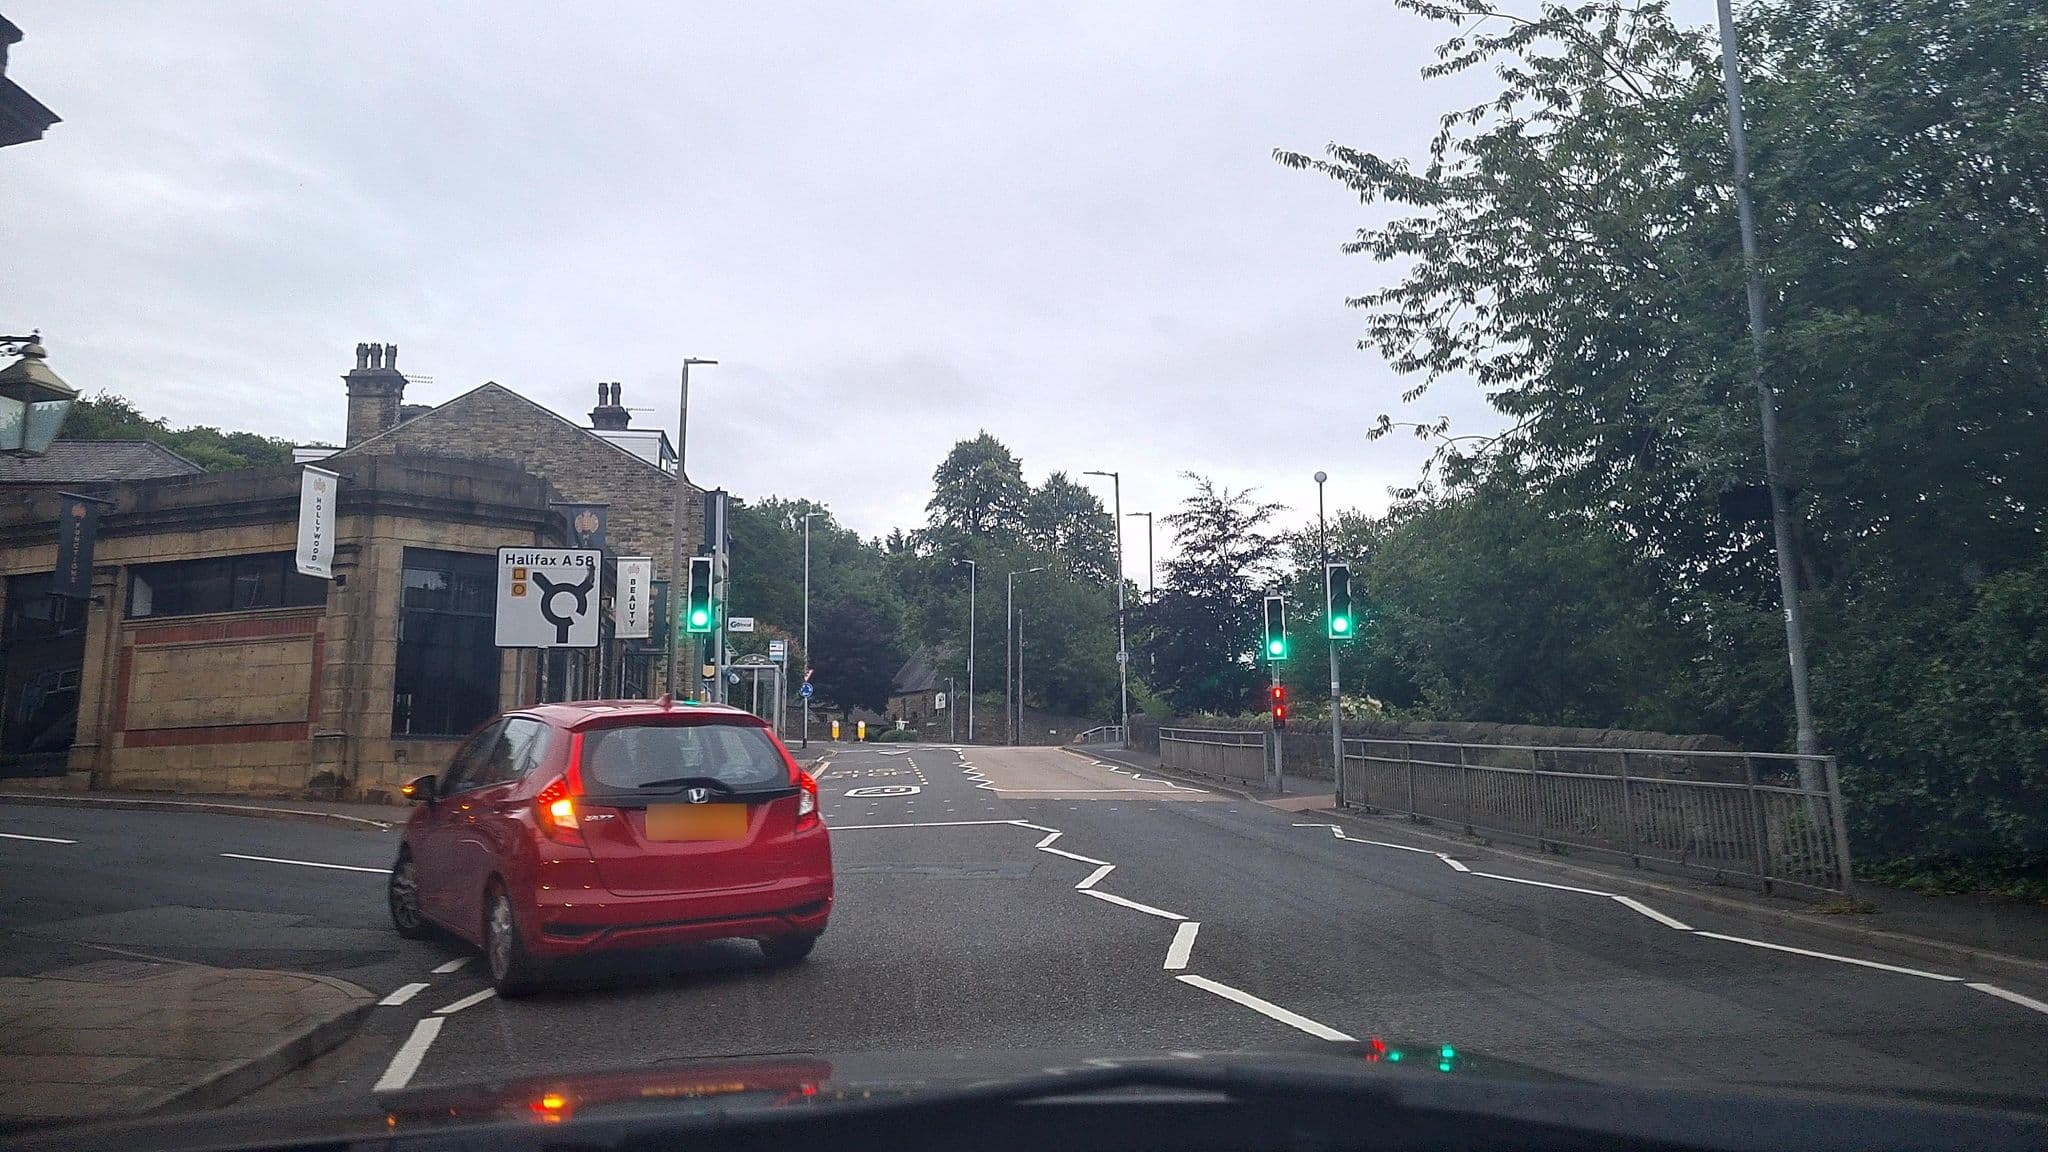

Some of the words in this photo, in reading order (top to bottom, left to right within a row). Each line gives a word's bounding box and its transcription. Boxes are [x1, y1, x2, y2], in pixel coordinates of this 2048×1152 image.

[311, 496, 322, 561] HOLLYWOOD
[505, 553, 557, 566] Halifax
[628, 578, 637, 627] BEAUTY
